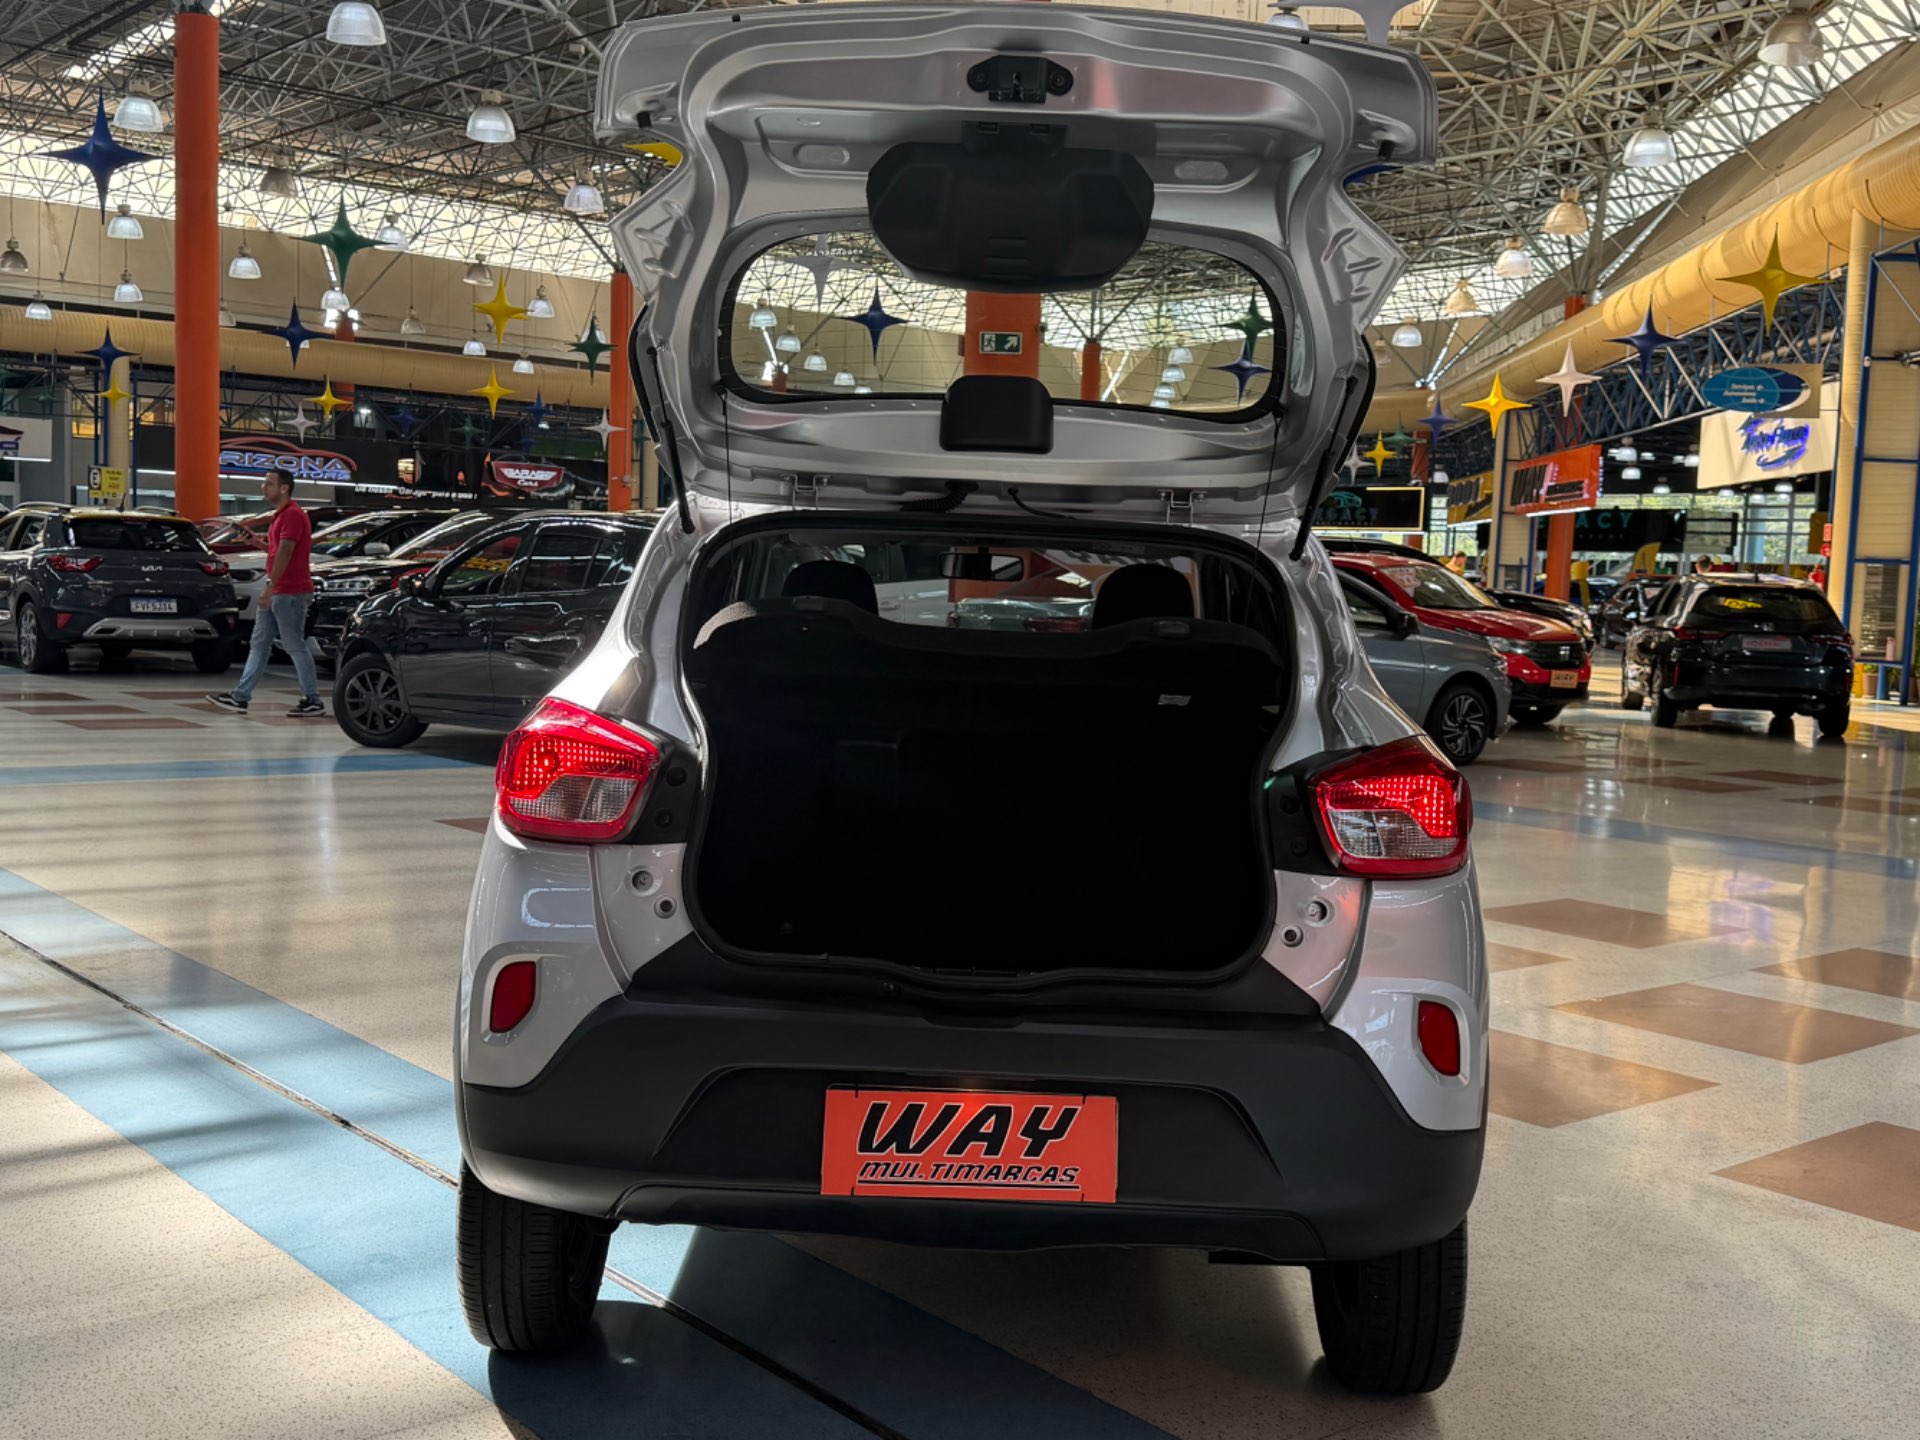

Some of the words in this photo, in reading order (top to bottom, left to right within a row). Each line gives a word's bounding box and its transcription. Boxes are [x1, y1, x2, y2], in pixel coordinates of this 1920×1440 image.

[219, 450, 351, 473] RIZONA
[856, 1101, 1082, 1159] WAY
[858, 1161, 1080, 1184] MULTIMARCAS
